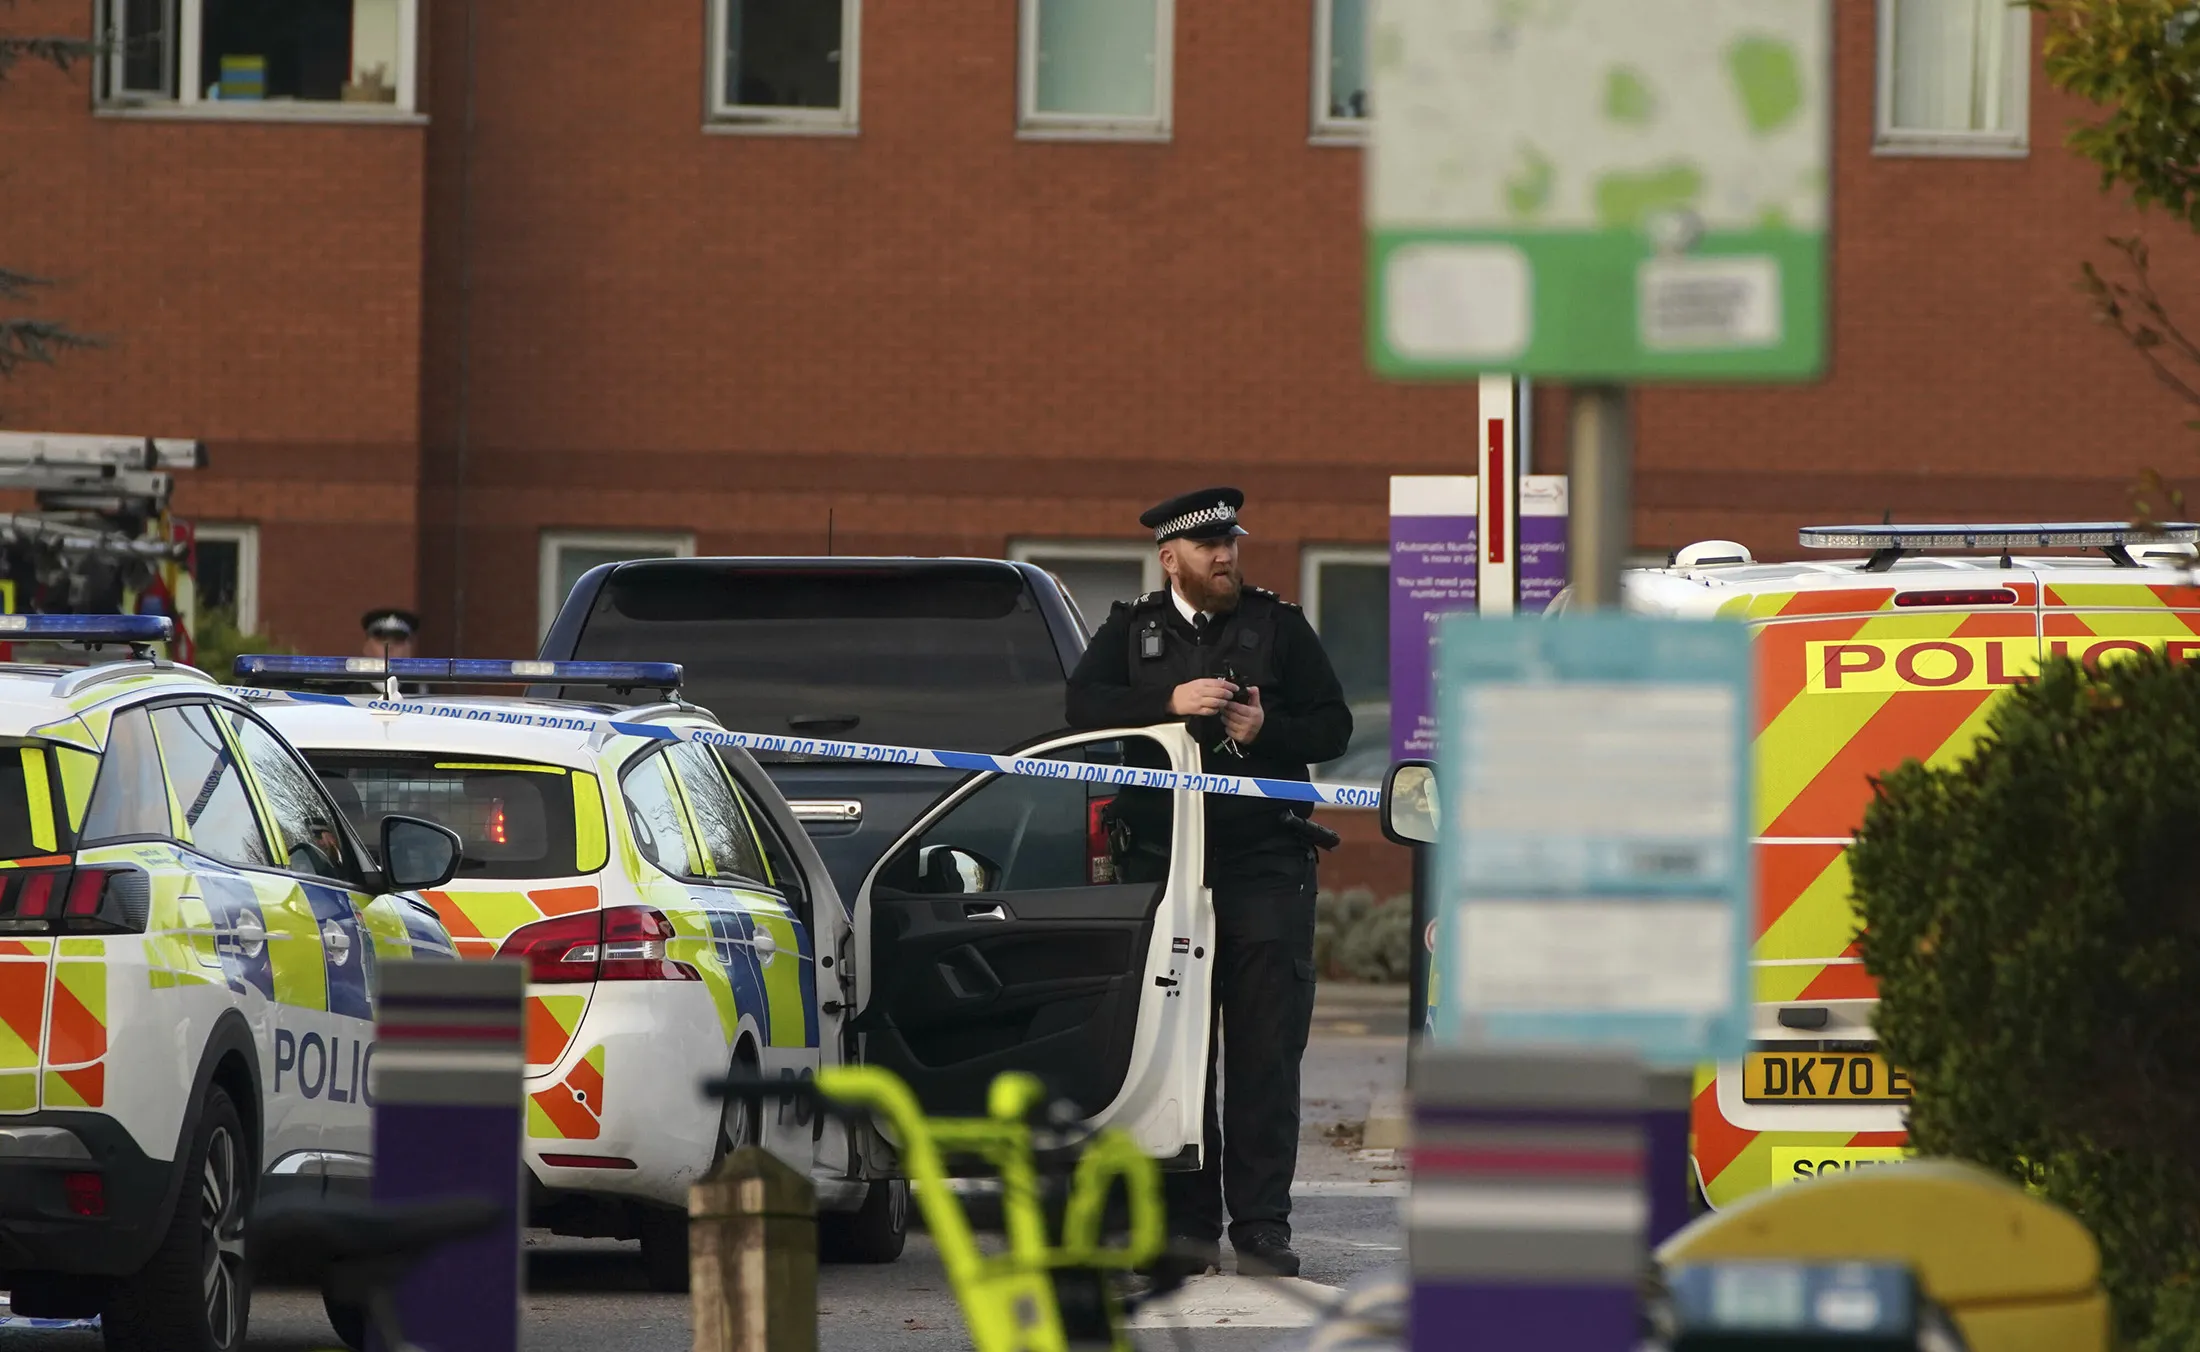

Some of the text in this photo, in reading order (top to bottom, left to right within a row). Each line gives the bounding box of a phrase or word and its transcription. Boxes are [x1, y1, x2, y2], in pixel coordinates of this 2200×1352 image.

[1447, 541, 1477, 552] Numb
[1520, 541, 1565, 553] cognition)
[1396, 577, 1415, 587] You
[1416, 577, 1433, 587] will
[1434, 577, 1458, 587] need
[1410, 588, 1446, 599] number
[691, 729, 919, 764] POLICE LINE DO NOT CROSS
[1014, 759, 1241, 793] POLICE LINE DO NOT CROSS
[1335, 787, 1380, 807] ROSS
[275, 1028, 377, 1108] POLIC
[1763, 1057, 1873, 1095] DK70
